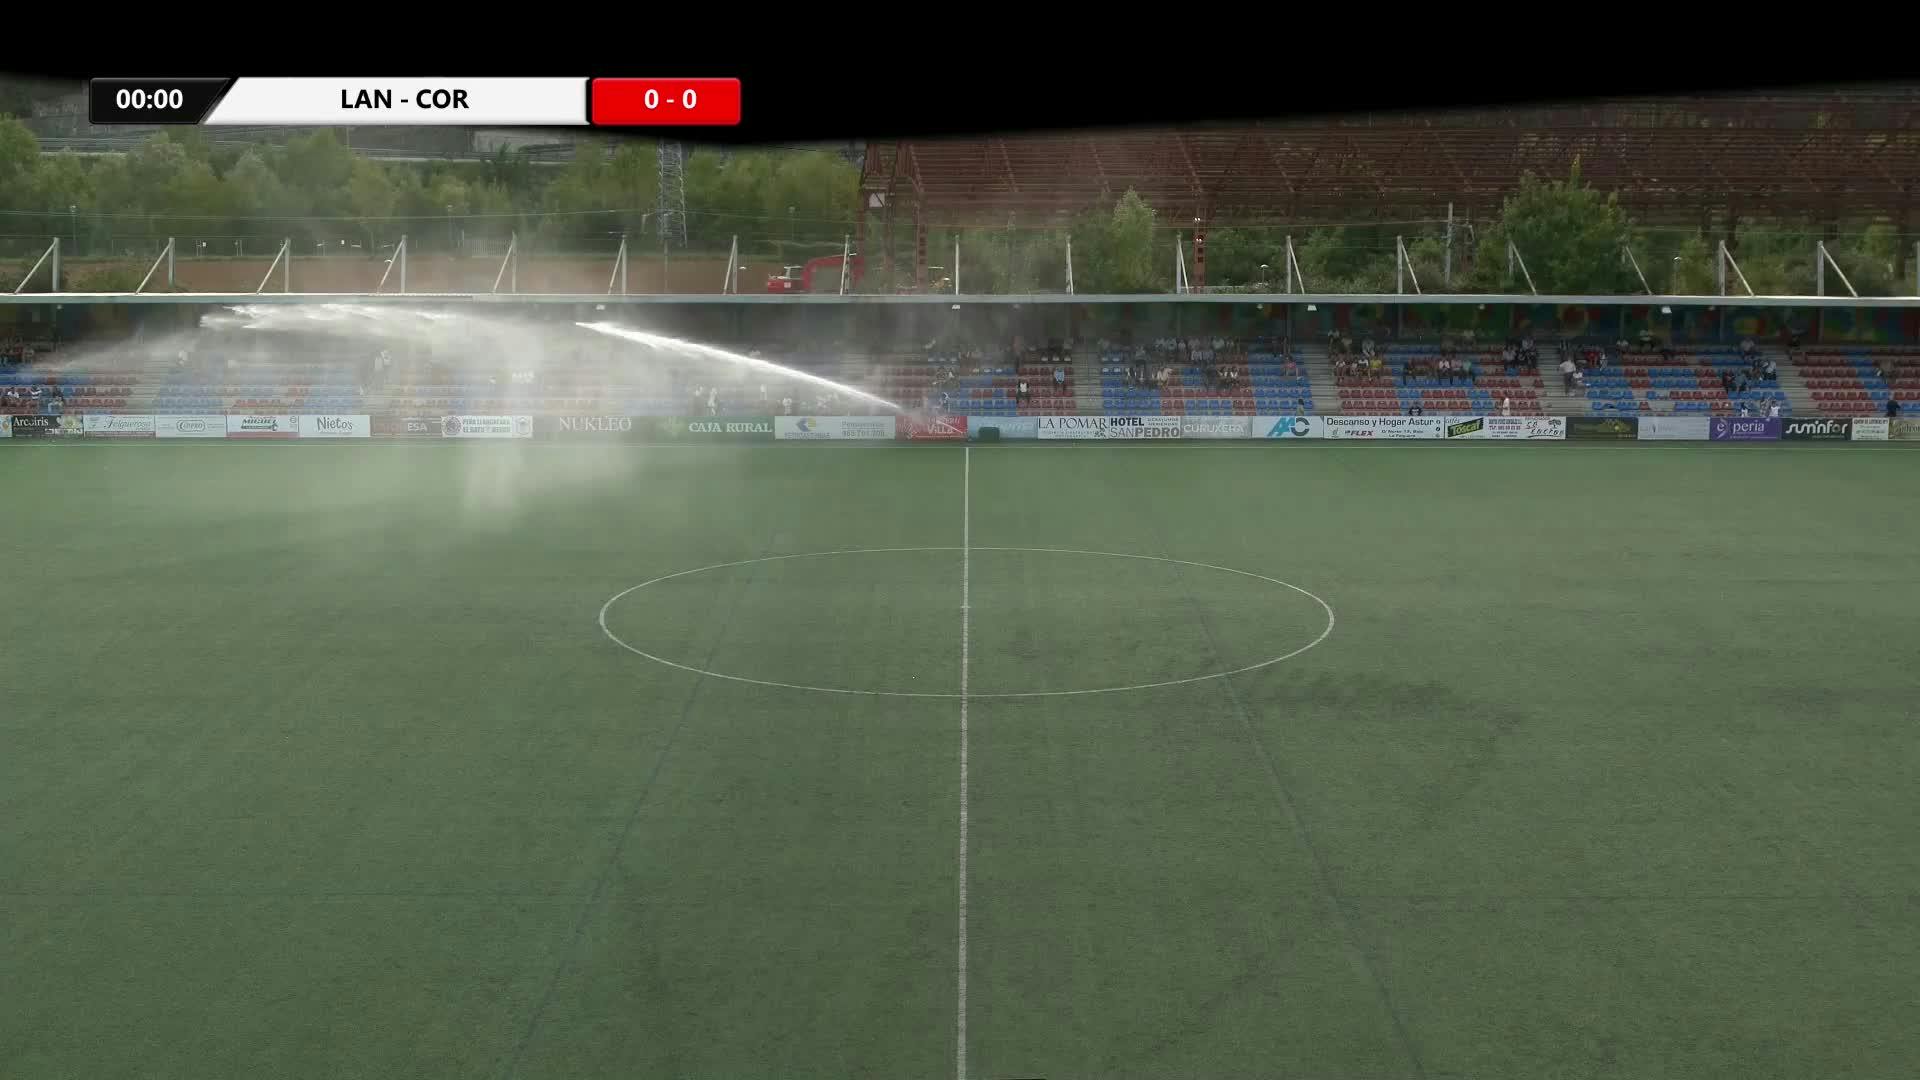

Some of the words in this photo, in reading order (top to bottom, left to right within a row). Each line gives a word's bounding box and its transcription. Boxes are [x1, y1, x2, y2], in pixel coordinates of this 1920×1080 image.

[317, 416, 353, 431] Nieto's
[559, 416, 632, 431] NUKLEO
[688, 422, 722, 433] CAJA
[726, 422, 772, 433] RURAL
[1038, 417, 1055, 429] LA
[1059, 417, 1107, 429] POMAR
[1110, 417, 1144, 427] HOTEL
[1326, 417, 1370, 426] Descanso
[1372, 419, 1377, 428] y
[1379, 417, 1406, 428] Hogar
[1408, 417, 1434, 426] Astur
